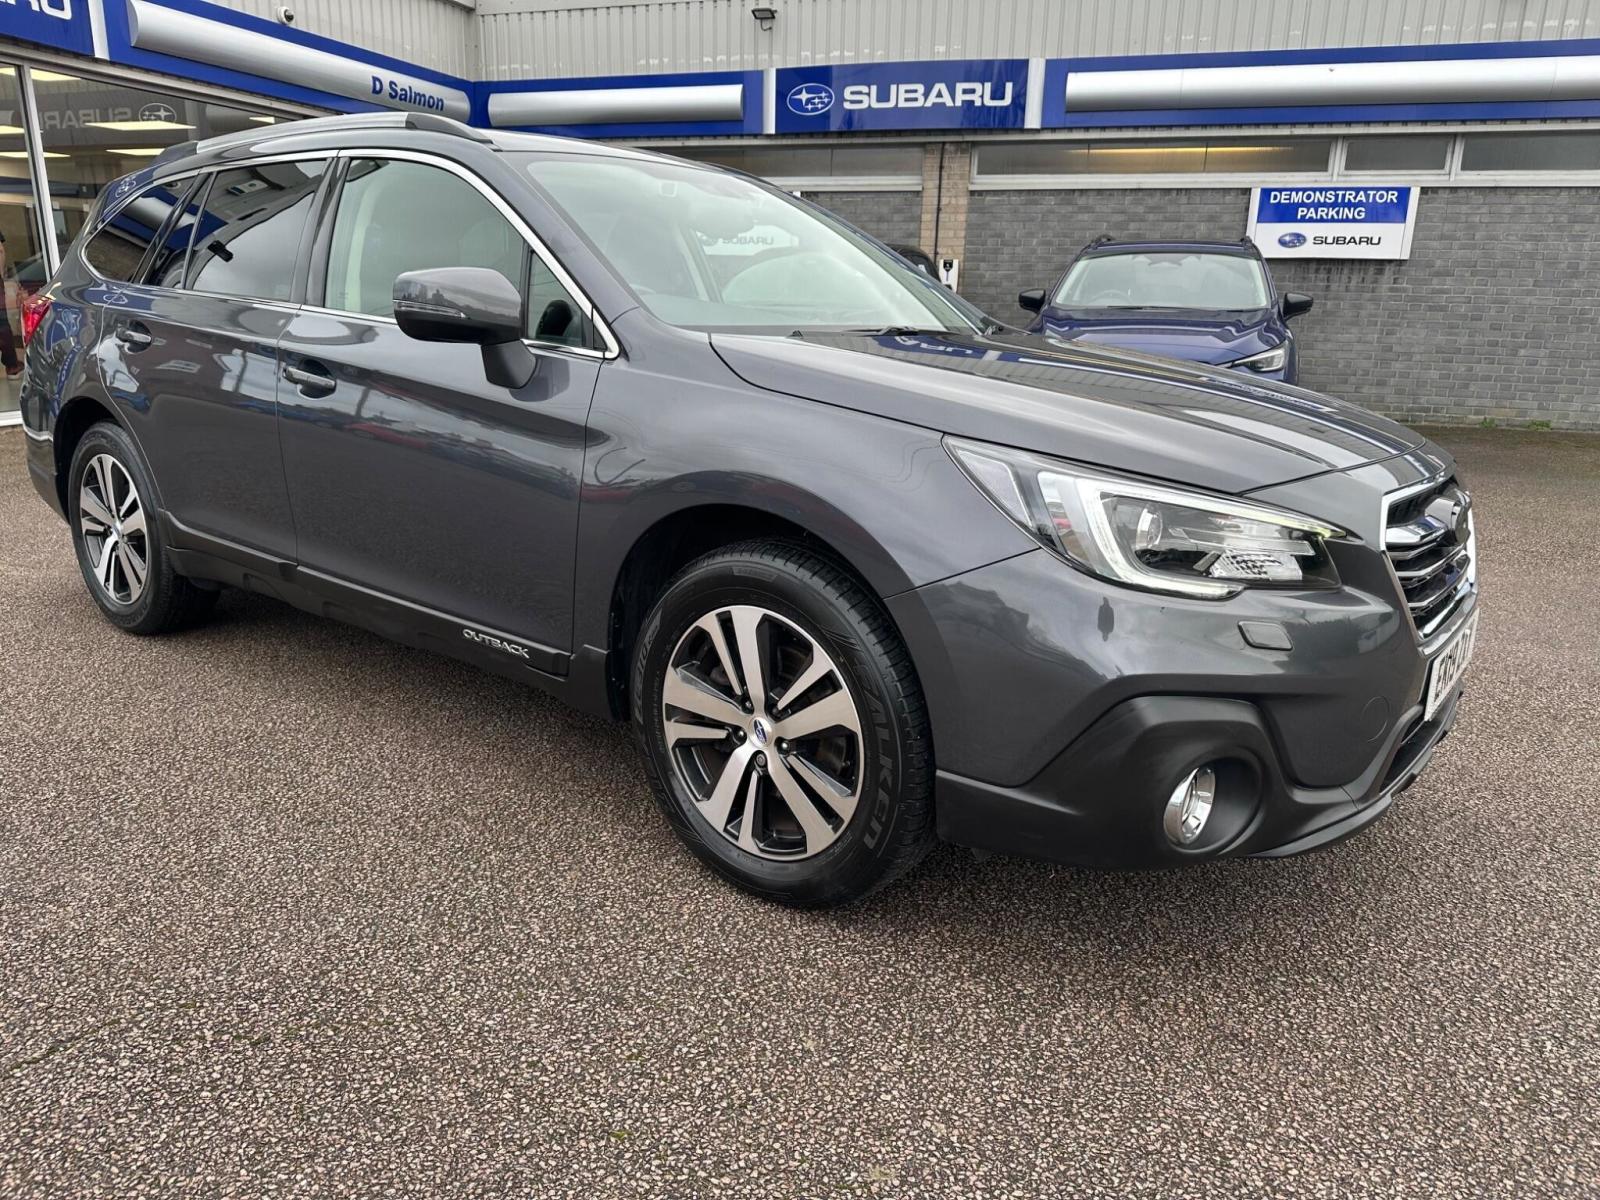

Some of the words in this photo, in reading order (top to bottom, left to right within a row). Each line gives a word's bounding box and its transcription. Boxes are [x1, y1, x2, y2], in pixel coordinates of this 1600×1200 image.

[371, 75, 384, 95] D
[388, 80, 445, 111] Salmon
[843, 81, 1013, 110] SUBARU
[1270, 190, 1398, 204] DEMONSTRATOR
[1297, 207, 1366, 220] PARKING
[1312, 236, 1381, 246] SUBARU
[462, 628, 530, 659] OUTBACK
